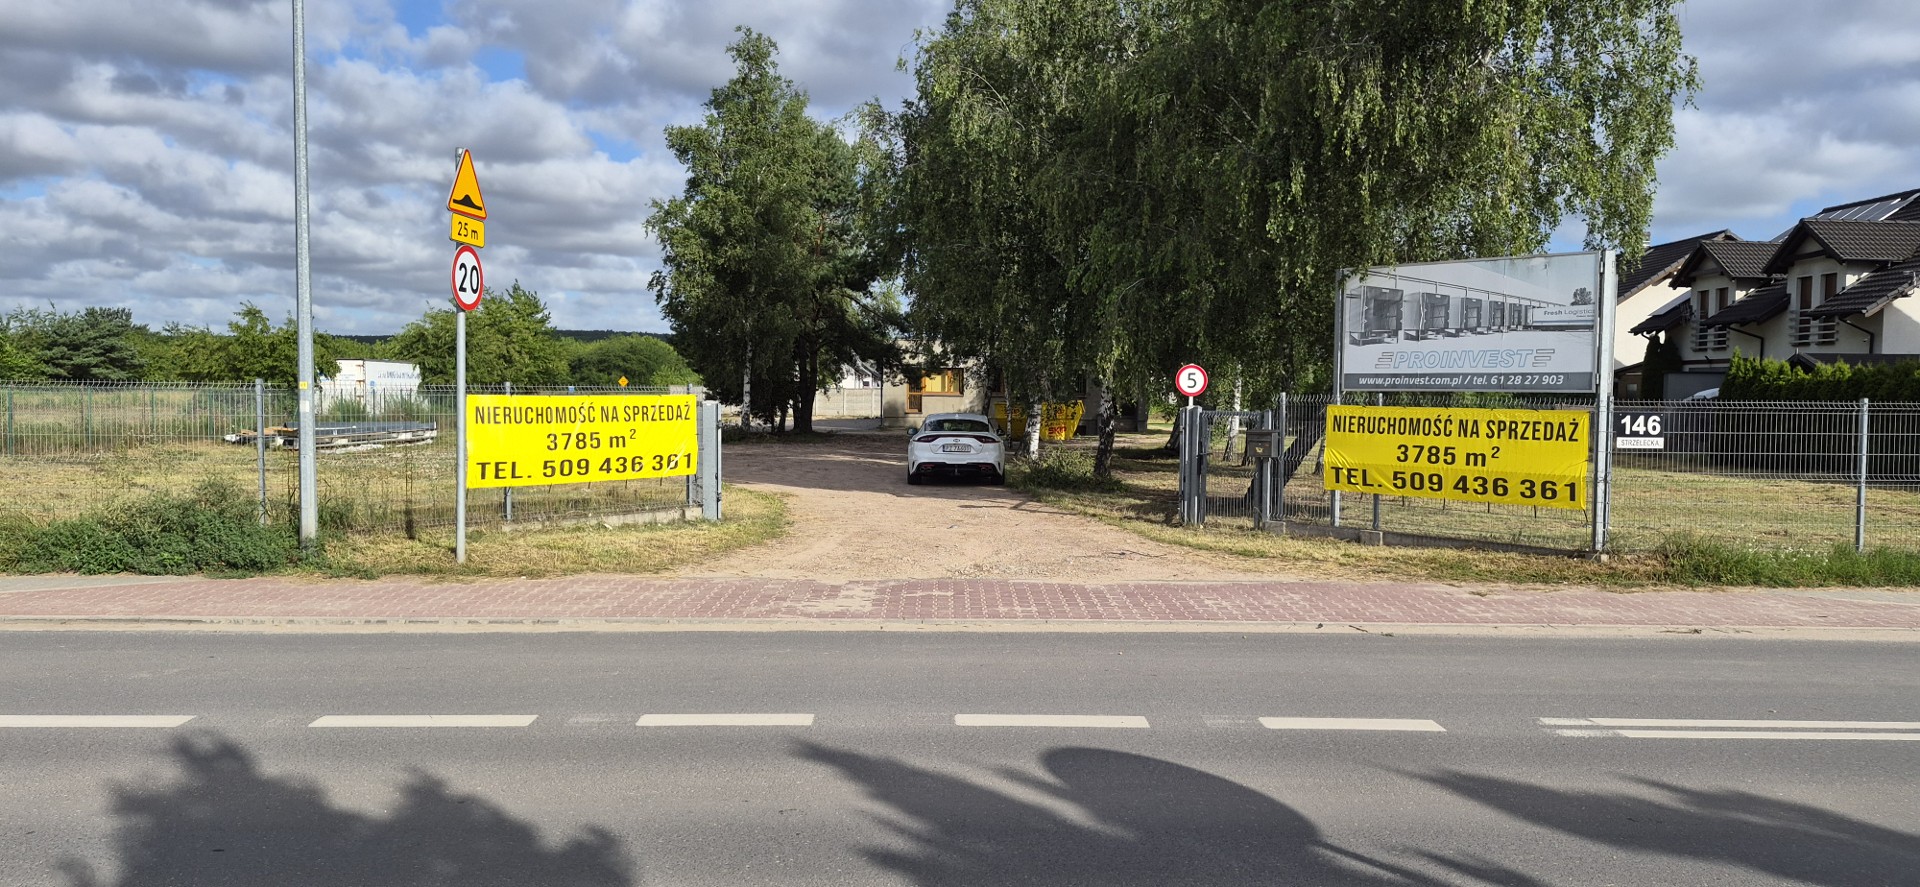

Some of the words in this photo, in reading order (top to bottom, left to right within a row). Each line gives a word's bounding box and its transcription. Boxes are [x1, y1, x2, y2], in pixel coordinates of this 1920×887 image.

[457, 221, 469, 238] 25
[470, 228, 479, 241] m
[458, 262, 480, 295] 20
[1393, 349, 1535, 369] PROINVEST
[1187, 372, 1197, 389] 5
[1359, 375, 1463, 387] www.proinvest.com.pl
[1472, 375, 1488, 385] tel.
[1490, 375, 1504, 385] 61
[1507, 375, 1522, 385] 28
[1524, 375, 1539, 385] 27
[1541, 375, 1564, 385] 903
[475, 402, 596, 424] NIERUCHOMOŚĆ
[601, 405, 619, 423] NA
[623, 401, 691, 422] SPRZEDAŻ
[1332, 414, 1453, 437] NIERUCHOMOŚĆ
[1458, 419, 1480, 439] NA
[1486, 418, 1579, 442] SPRZEDAŻ
[1621, 415, 1661, 436] 146
[546, 432, 601, 451] 3785
[1621, 439, 1660, 447] STRZELECKA
[1396, 444, 1456, 465] 3785
[476, 461, 532, 480] TEL.
[543, 458, 590, 478] 509
[598, 455, 644, 475] 436
[652, 452, 692, 472] 361
[1331, 466, 1383, 488] TEL.
[1392, 471, 1444, 492] 509
[1453, 475, 1509, 496] 436
[1520, 479, 1576, 502] 361
